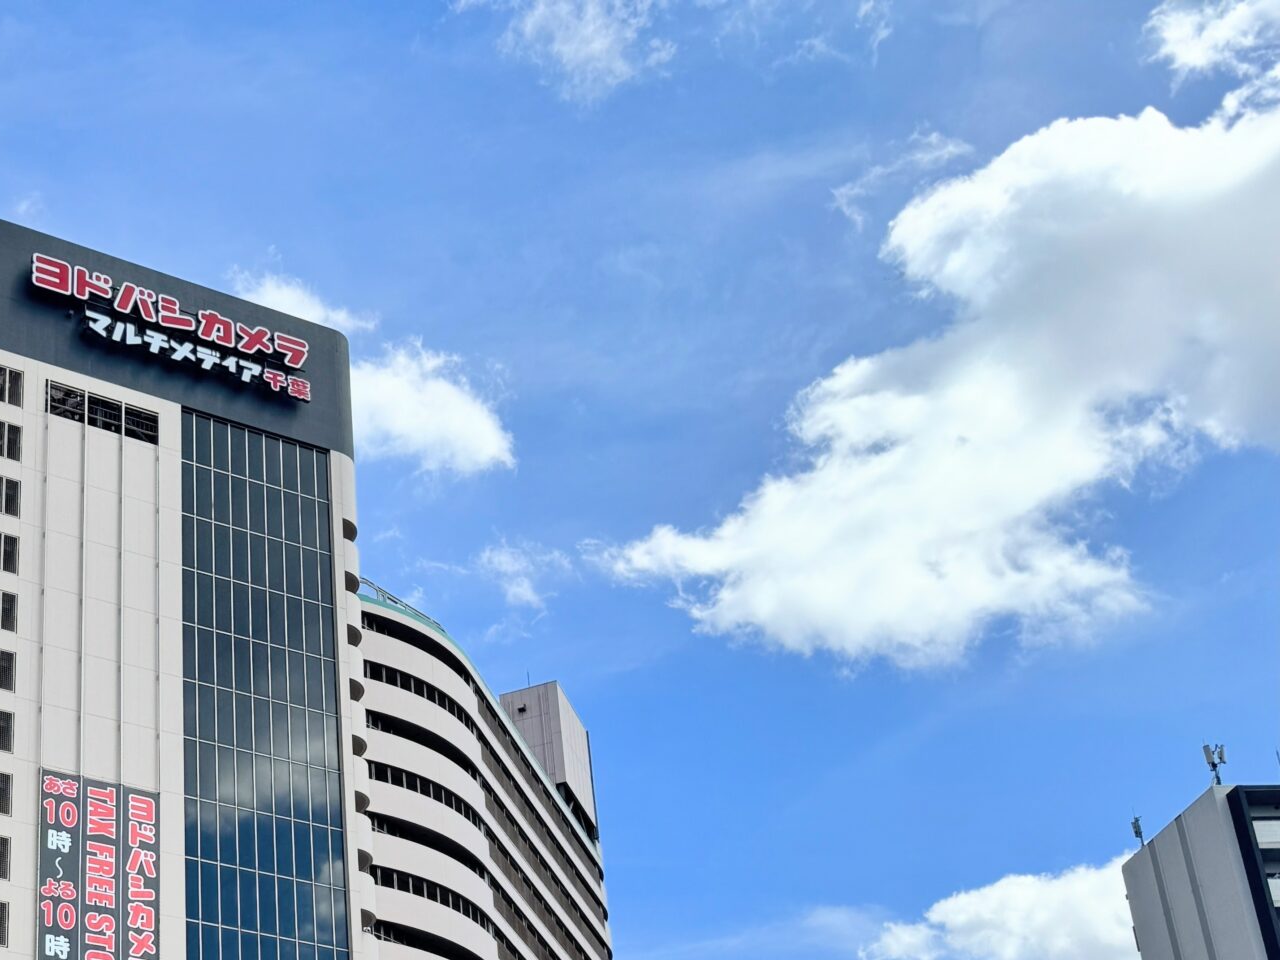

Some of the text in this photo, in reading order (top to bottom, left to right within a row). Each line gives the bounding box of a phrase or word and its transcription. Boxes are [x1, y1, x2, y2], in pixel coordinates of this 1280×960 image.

[31, 253, 310, 369] ヨドバシカメラ
[85, 309, 311, 403] マルチメディア千葉
[87, 786, 116, 839] TAX
[86, 841, 115, 909] FREE
